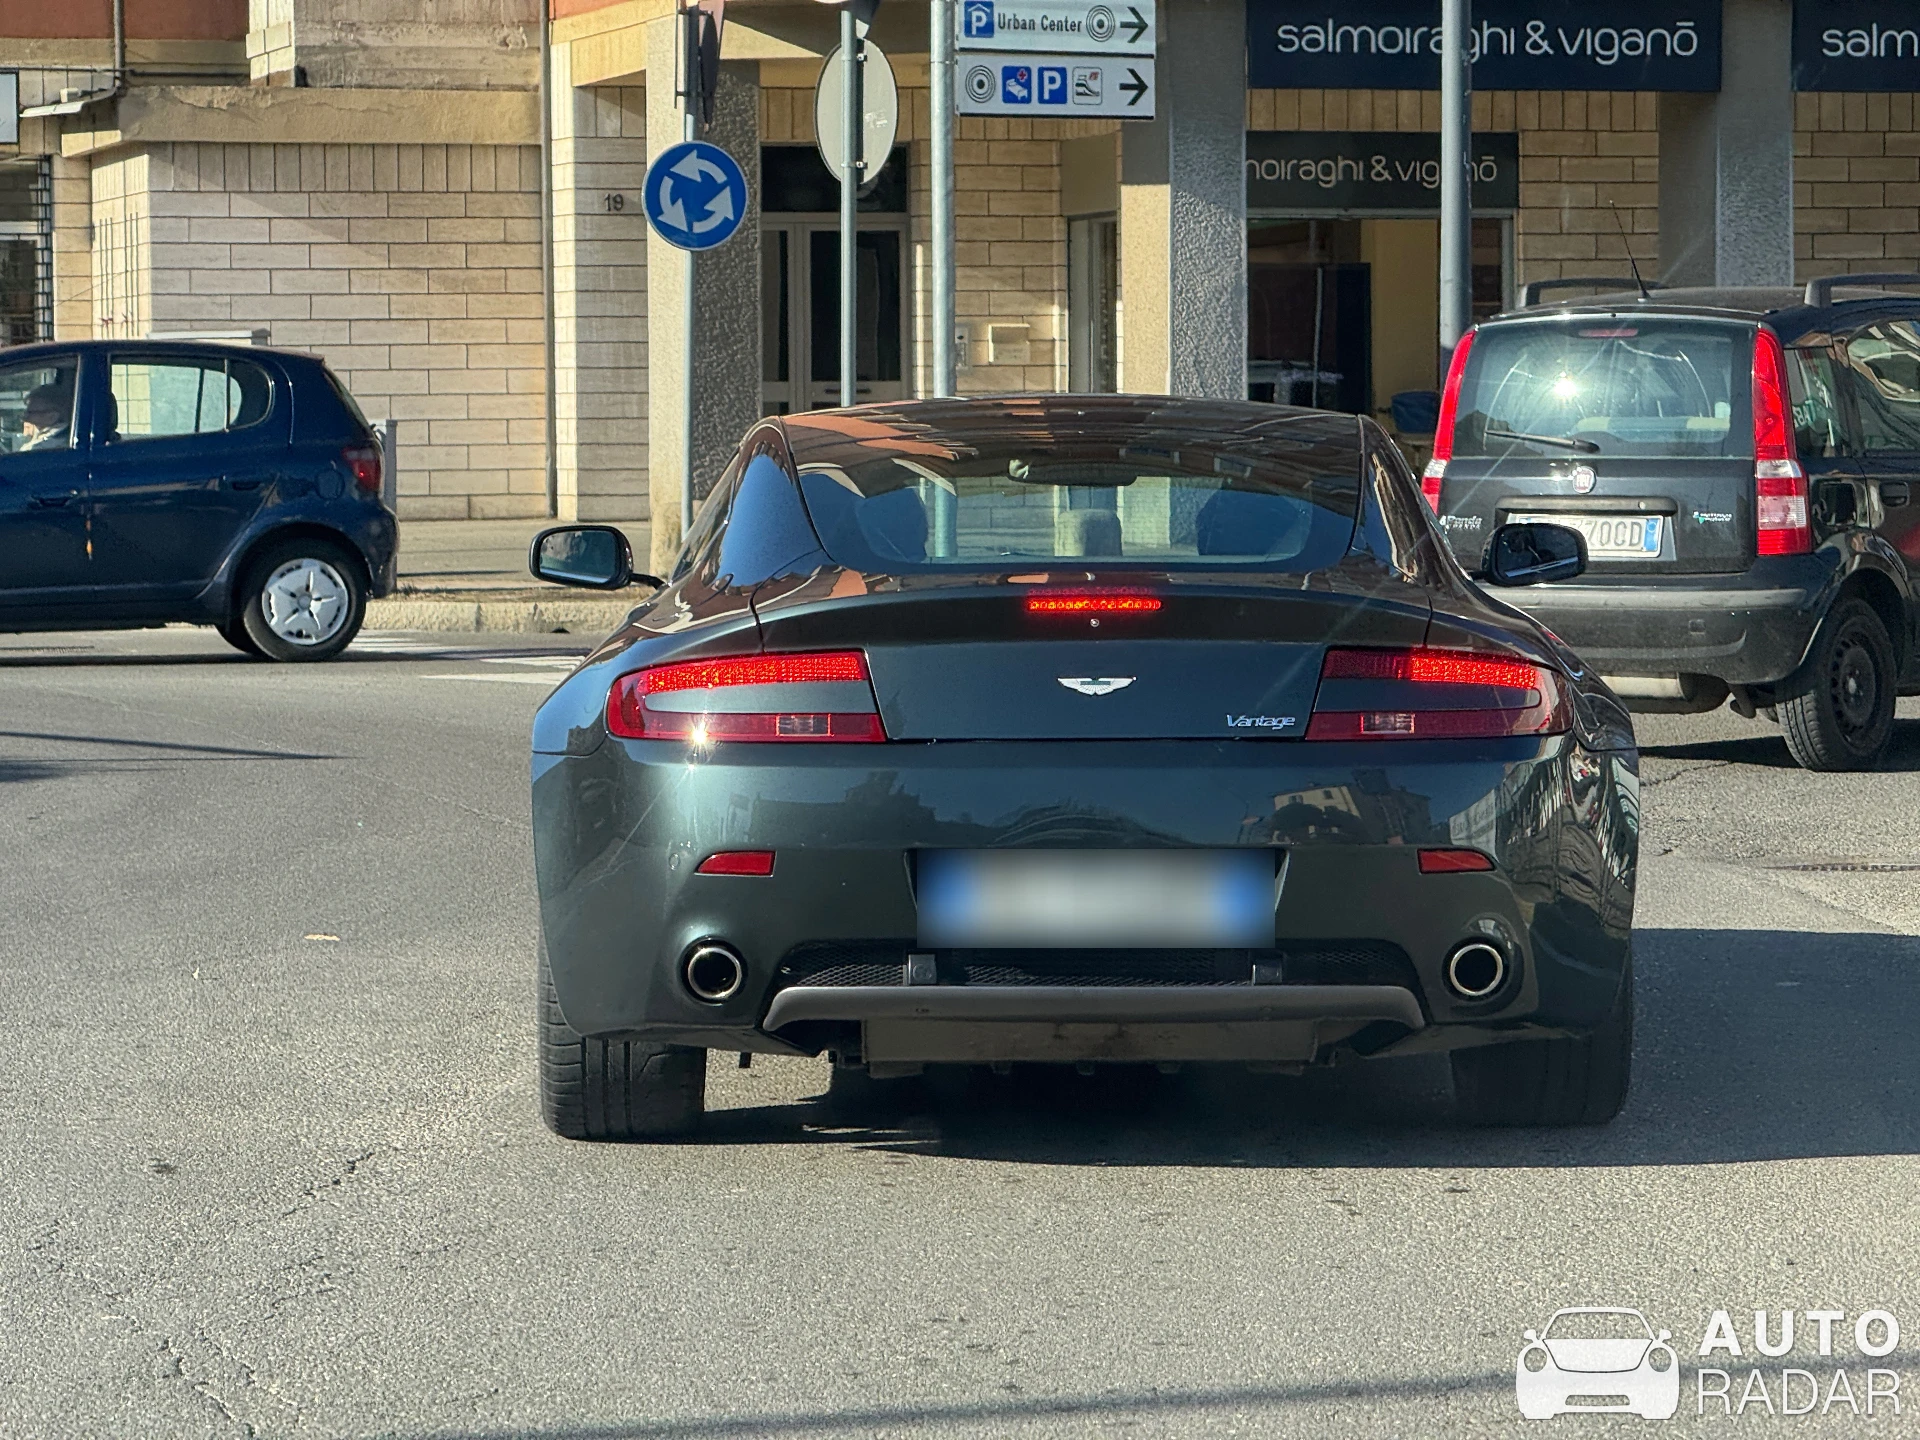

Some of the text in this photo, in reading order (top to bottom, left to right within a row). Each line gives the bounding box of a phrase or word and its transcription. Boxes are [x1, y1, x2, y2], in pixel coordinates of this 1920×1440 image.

[997, 12, 1036, 31] Urban
[1040, 14, 1083, 33] Center
[1525, 20, 1554, 55] &
[1370, 155, 1392, 182] &
[604, 193, 624, 211] 19
[1226, 714, 1296, 731] Vantage
